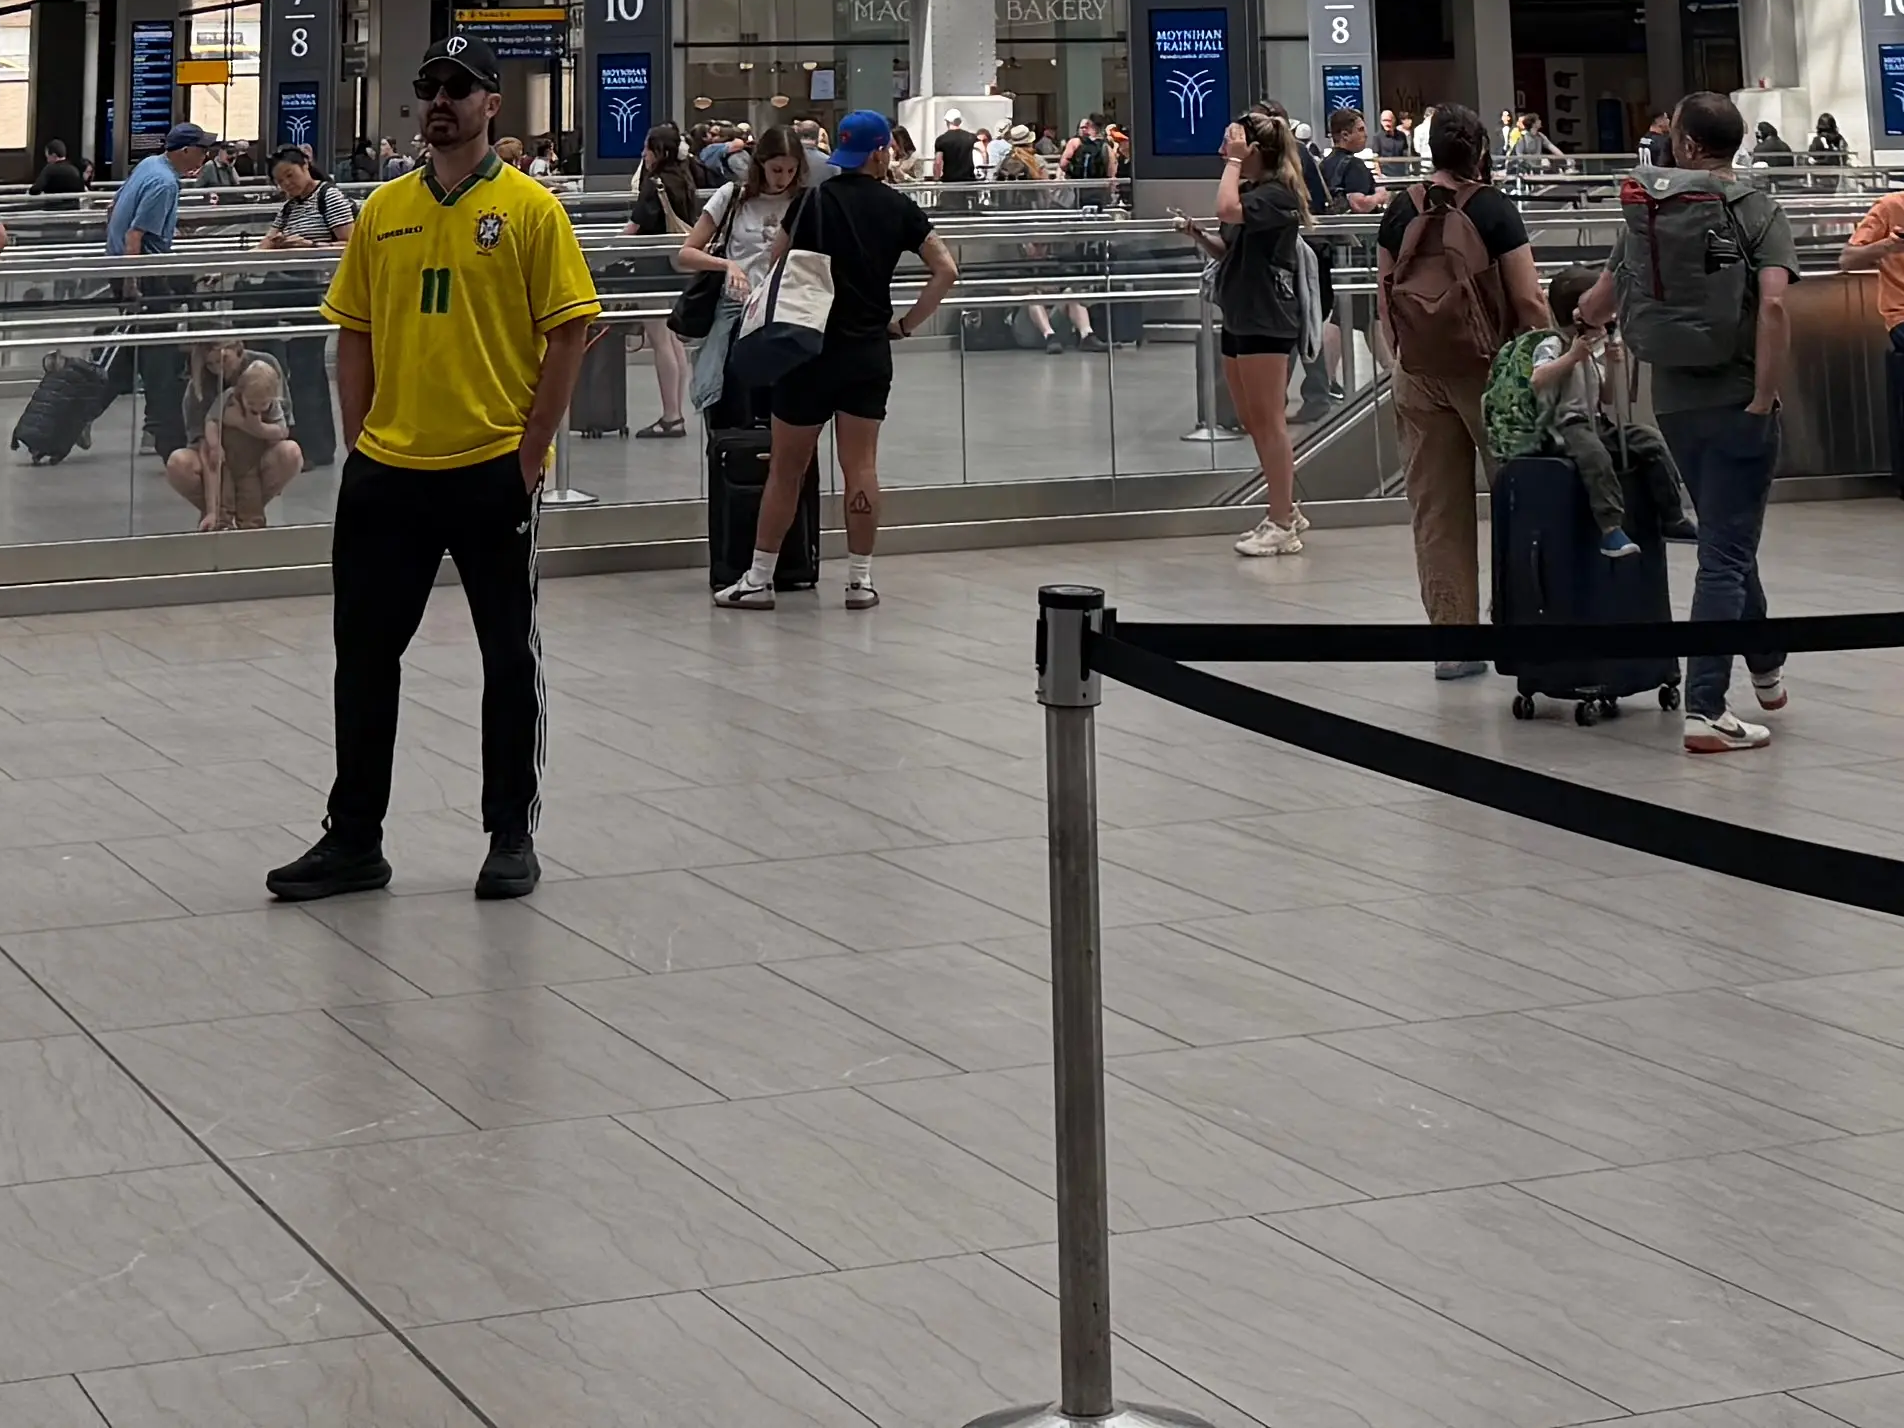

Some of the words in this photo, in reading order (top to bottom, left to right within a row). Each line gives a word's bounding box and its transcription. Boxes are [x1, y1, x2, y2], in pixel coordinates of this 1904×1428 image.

[1006, 0, 1108, 21] BAKERY
[291, 27, 309, 57] 8
[1156, 29, 1222, 41] MOYNIHAN
[1331, 16, 1350, 44] 8
[1156, 40, 1191, 52] TRAIN
[1194, 40, 1224, 51] HALL
[420, 267, 451, 314] 11
